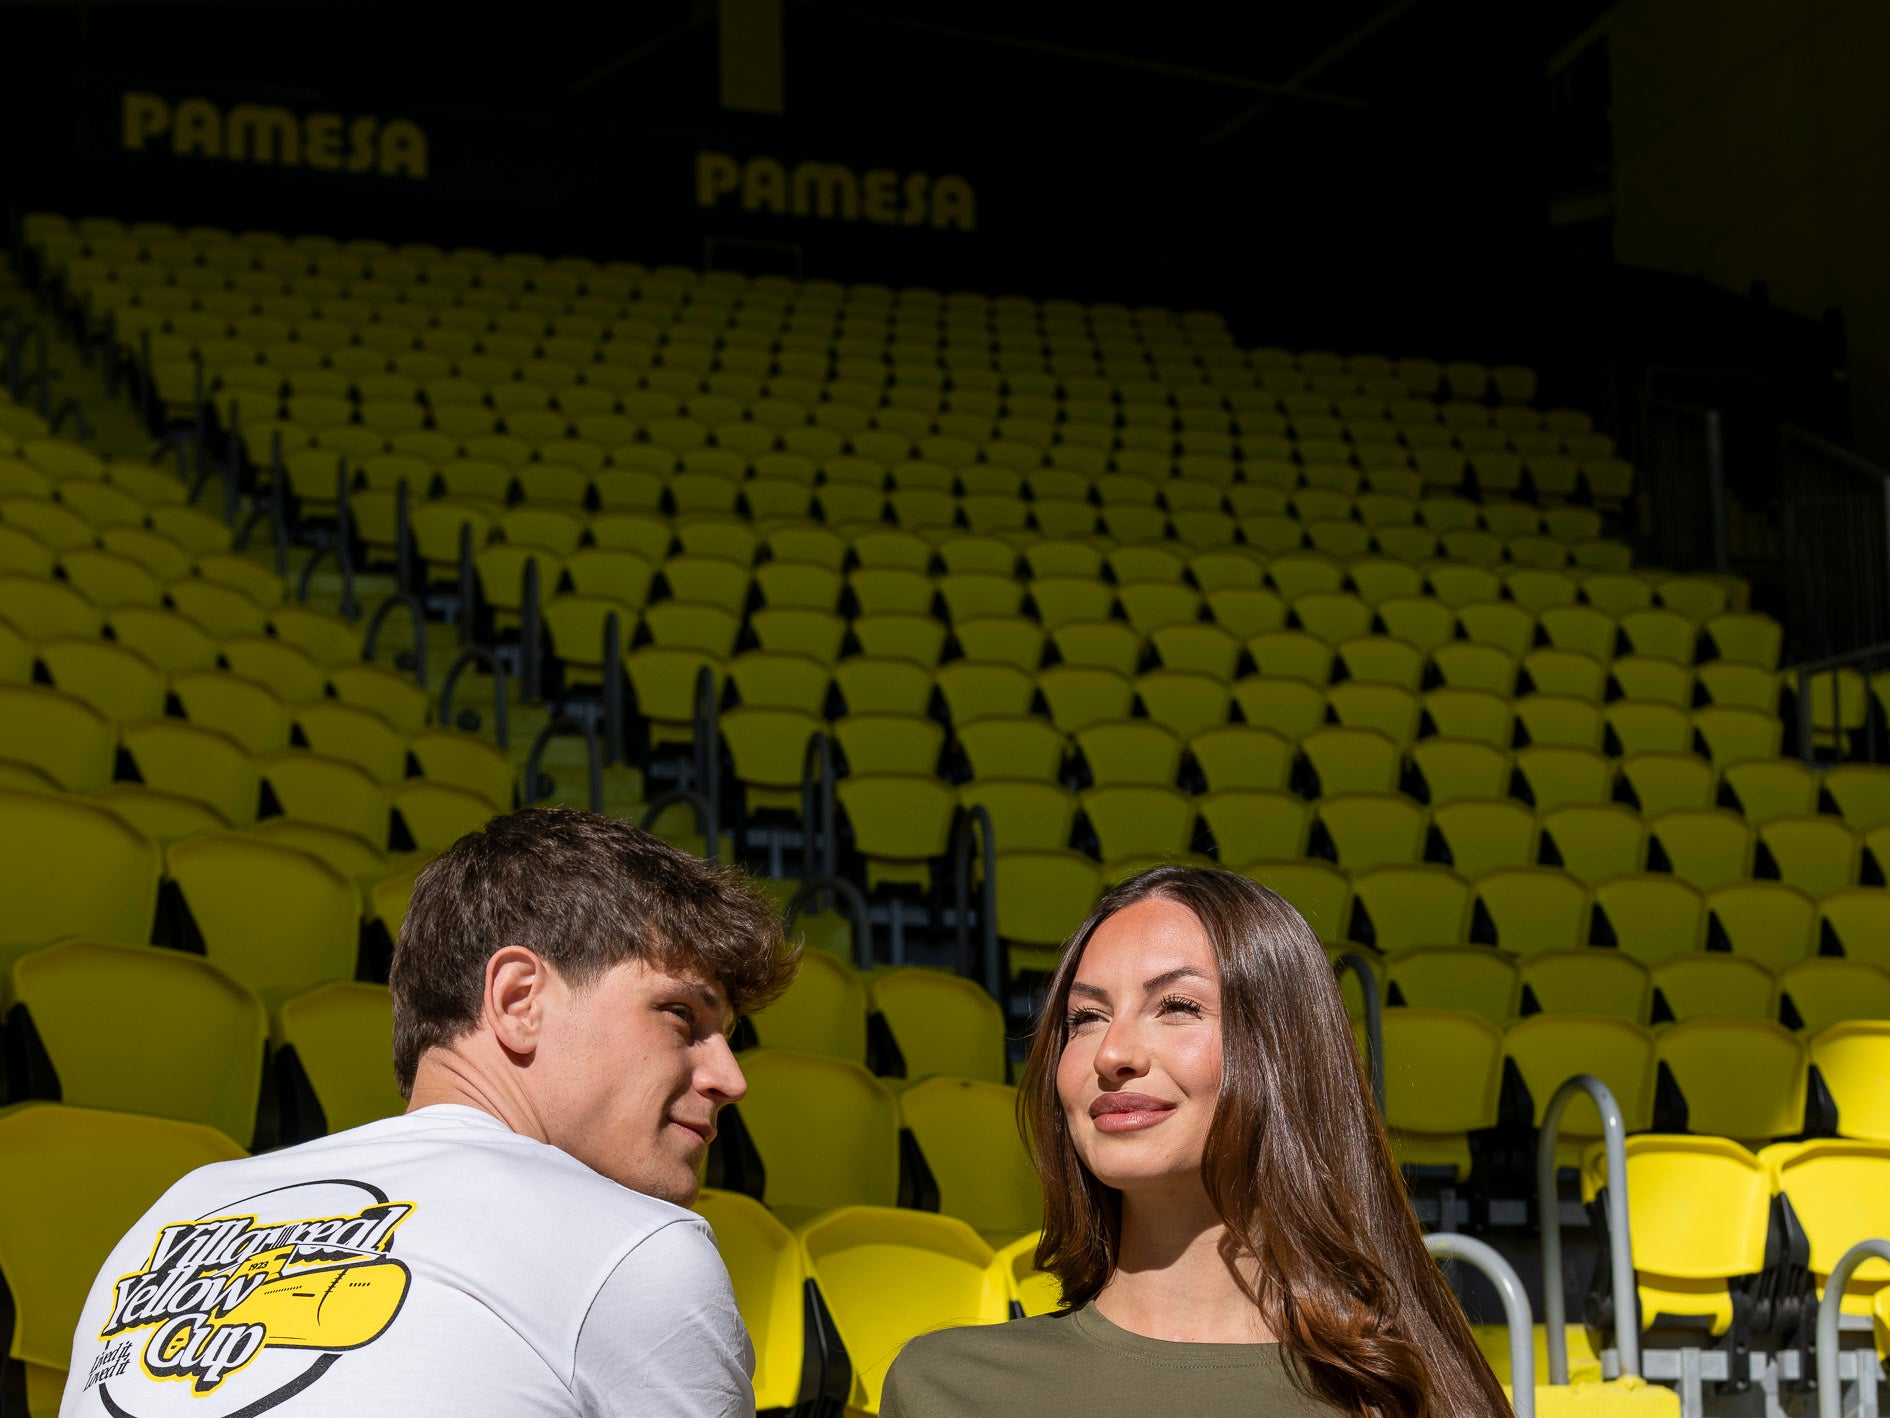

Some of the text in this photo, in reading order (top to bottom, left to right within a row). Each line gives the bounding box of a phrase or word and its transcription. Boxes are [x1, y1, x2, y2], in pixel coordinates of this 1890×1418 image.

[121, 91, 429, 179] PAMESA
[695, 150, 977, 232] PAMESA
[150, 1204, 414, 1273] Villarreal
[248, 1260, 269, 1272] 1923
[102, 1264, 266, 1336] Yellow
[83, 1359, 130, 1392] Loved it
[89, 1342, 123, 1375] Lived
[145, 1313, 266, 1391] Cup
